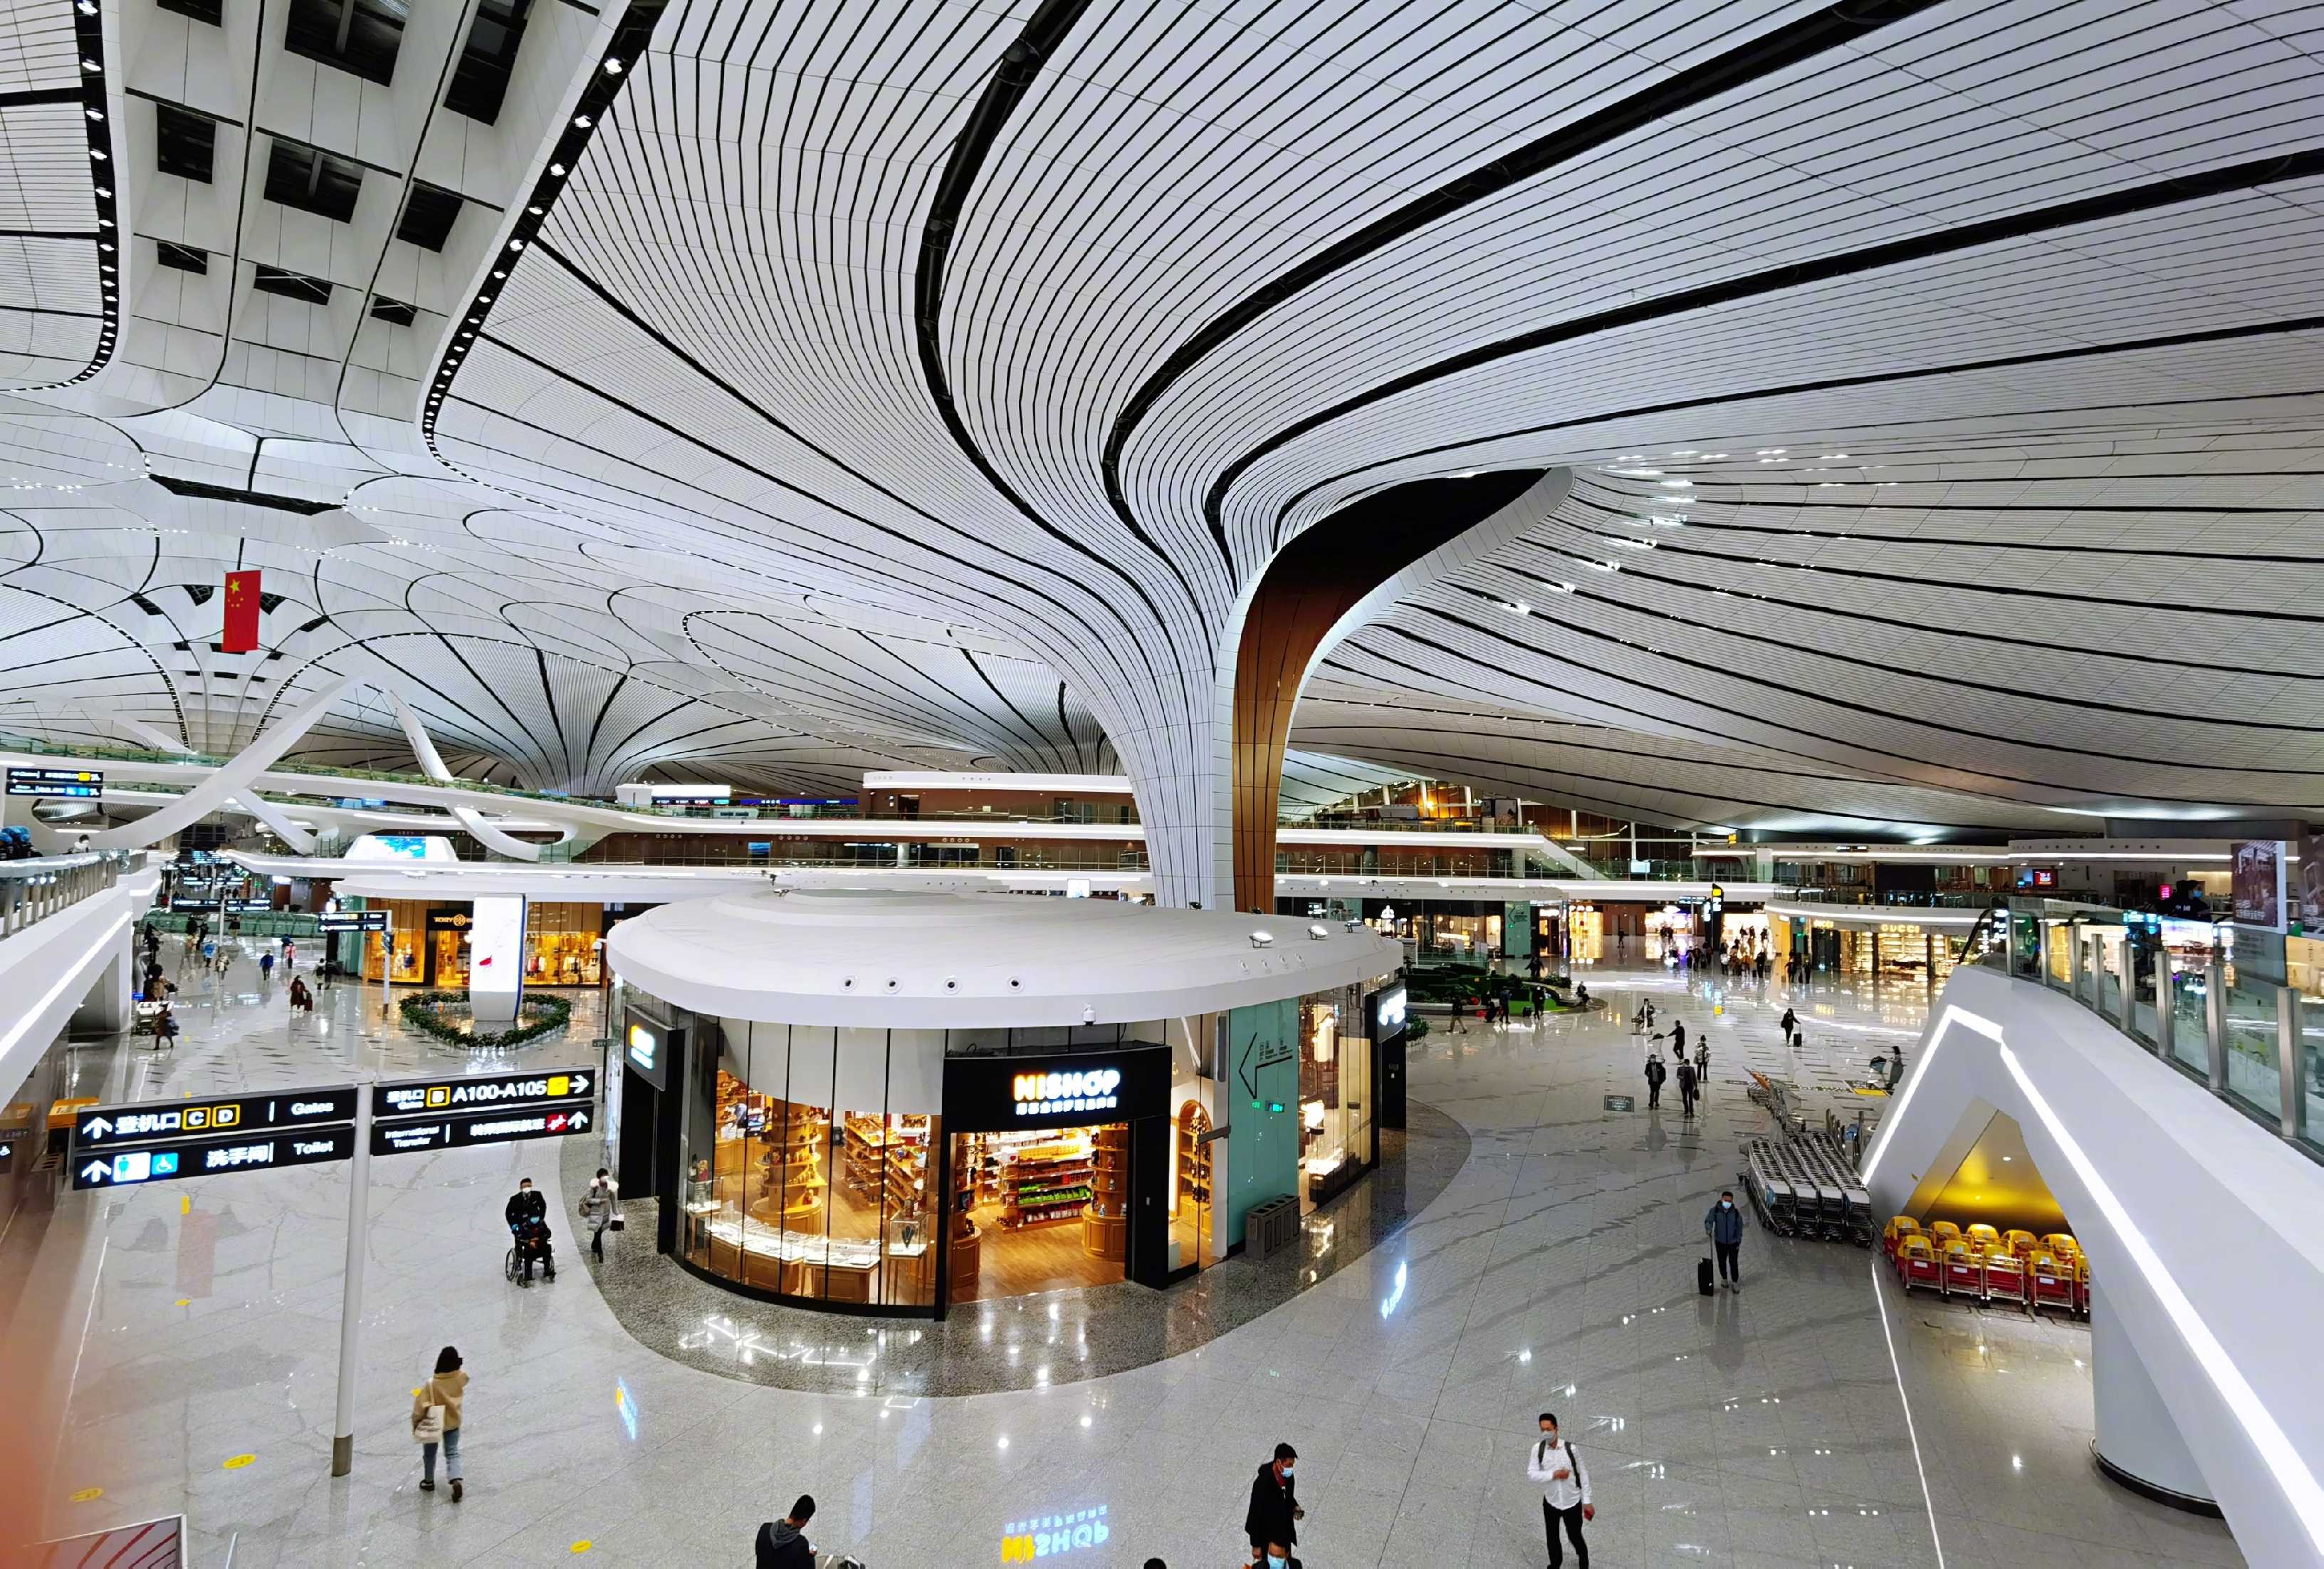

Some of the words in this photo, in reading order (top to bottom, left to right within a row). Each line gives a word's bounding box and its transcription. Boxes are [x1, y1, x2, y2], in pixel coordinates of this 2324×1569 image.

[1880, 924, 1920, 933] GUCCI
[452, 1080, 548, 1103] A100-A105
[115, 1112, 181, 1135] 登机口
[188, 1111, 204, 1125] C
[218, 1109, 234, 1123] D
[291, 1103, 334, 1115] Gates
[207, 1145, 268, 1167] 洗手间
[293, 1140, 334, 1155] Toilet
